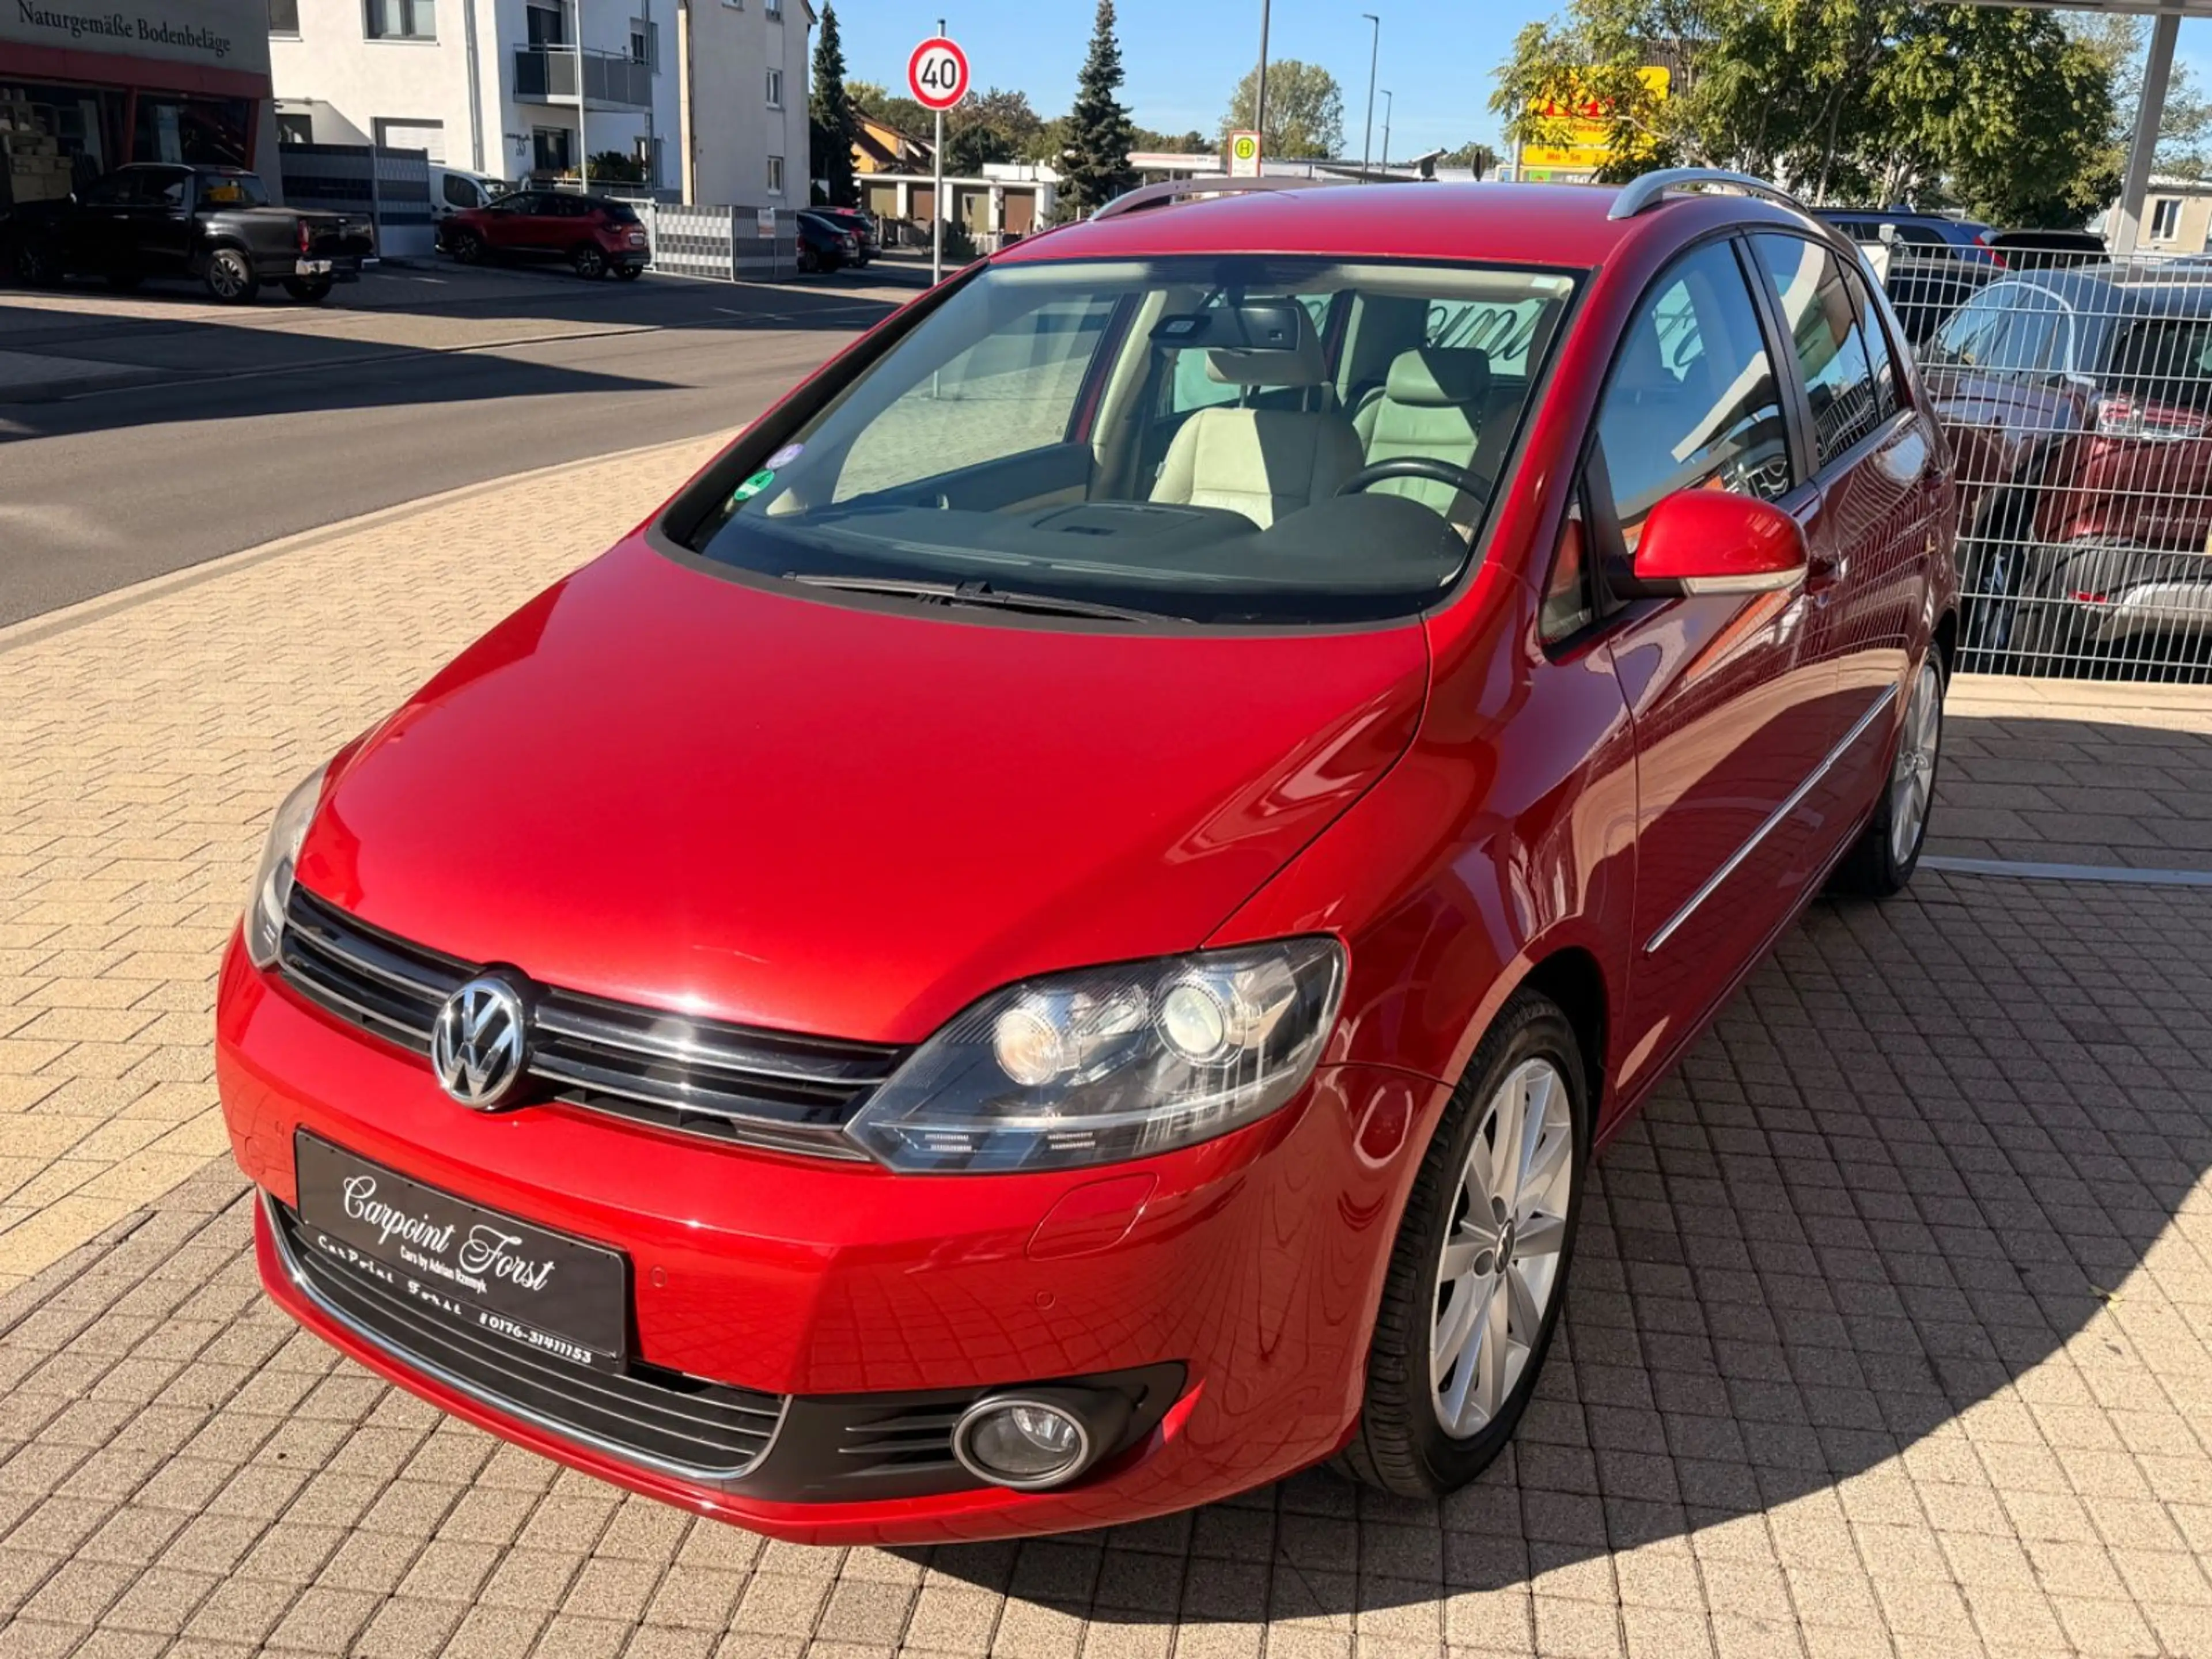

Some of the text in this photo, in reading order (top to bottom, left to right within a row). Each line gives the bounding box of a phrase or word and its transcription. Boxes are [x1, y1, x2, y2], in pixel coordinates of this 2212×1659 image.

[17, 0, 230, 58] Naturgemäße Bodenbeläge
[921, 58, 956, 89] 40
[1240, 143, 1249, 154] H
[343, 1176, 555, 1290] Carpoint Forst
